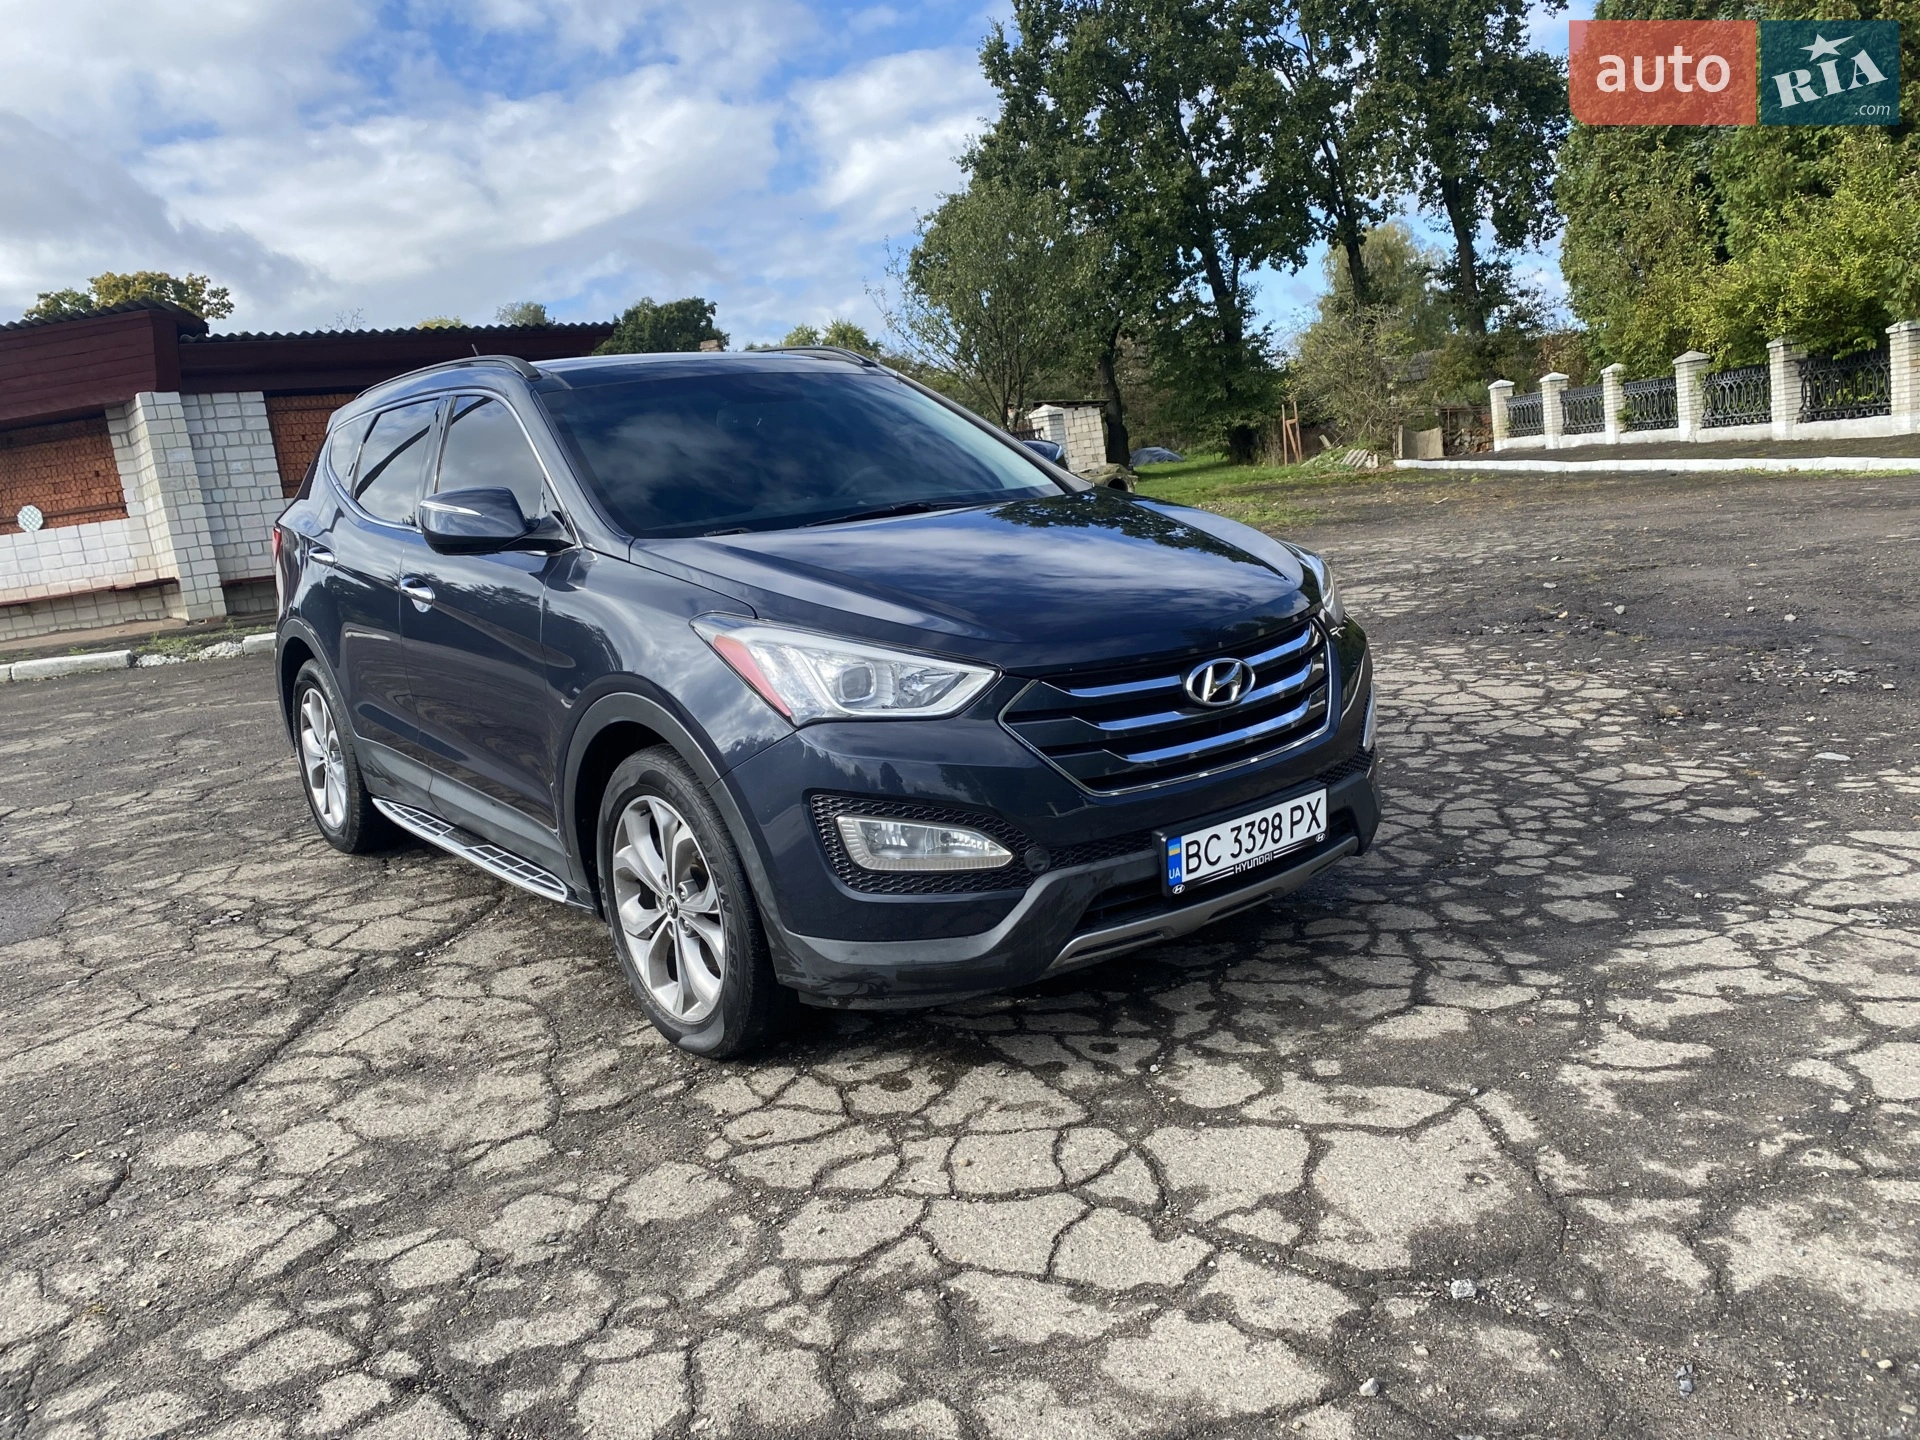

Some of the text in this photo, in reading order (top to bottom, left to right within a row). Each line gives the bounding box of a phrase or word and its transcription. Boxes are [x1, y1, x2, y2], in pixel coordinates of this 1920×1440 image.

[664, 781, 733, 915] ROADIAN
[1185, 797, 1322, 876] BC 3398 PX
[1168, 868, 1181, 880] UA
[1234, 851, 1274, 875] HYUNDAI
